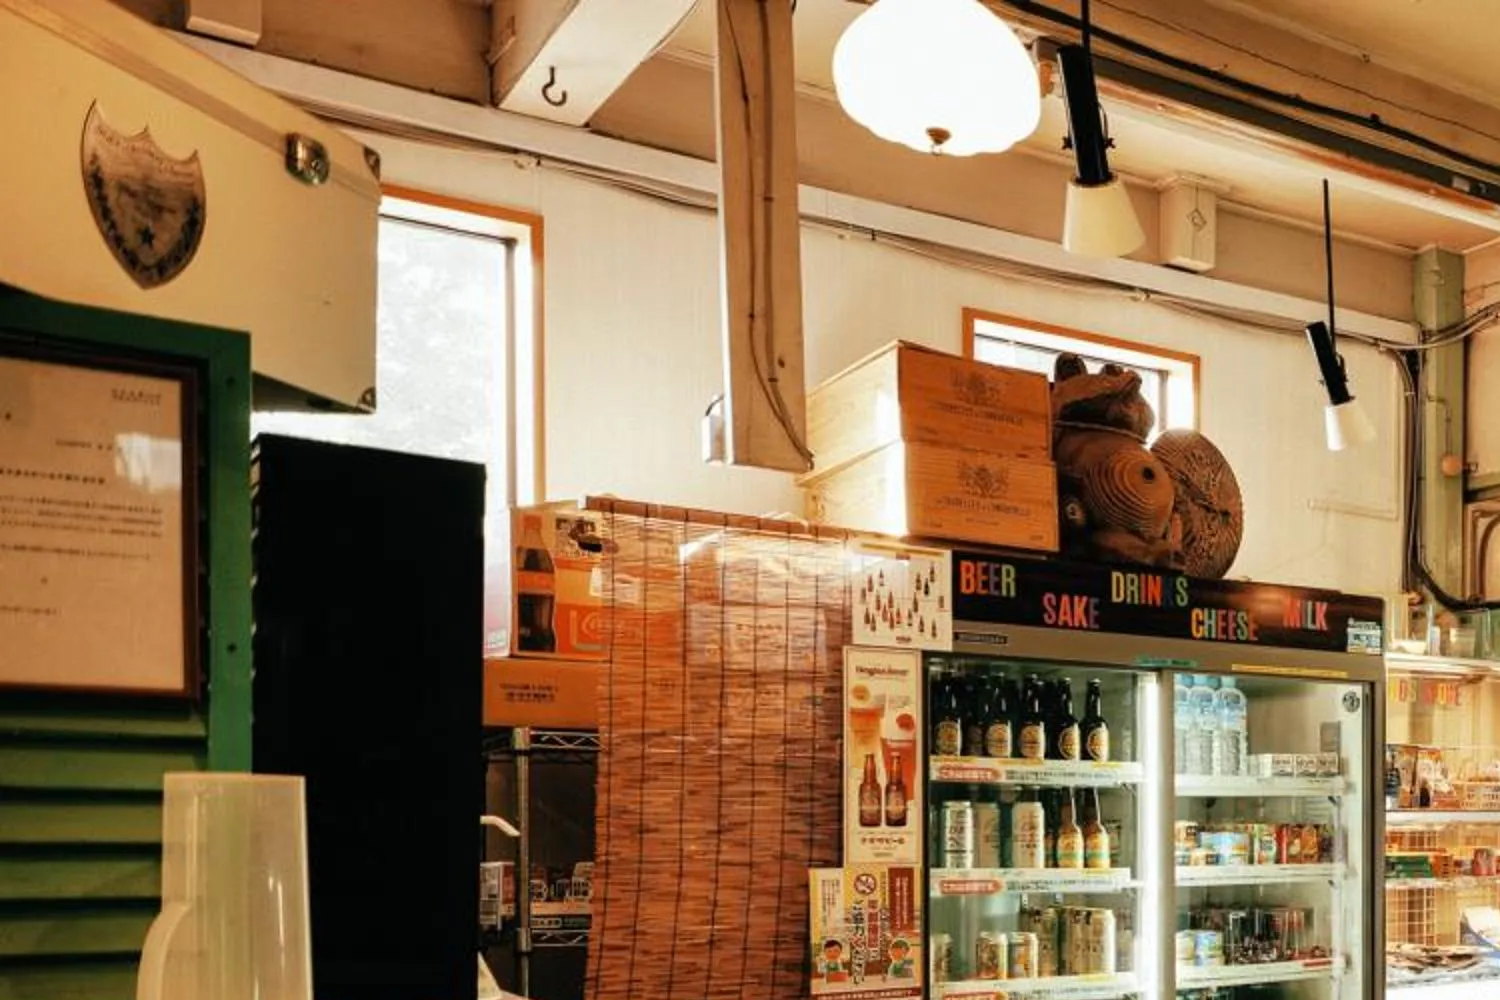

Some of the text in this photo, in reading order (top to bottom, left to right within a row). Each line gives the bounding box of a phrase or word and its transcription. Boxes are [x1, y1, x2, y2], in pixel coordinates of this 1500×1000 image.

[959, 559, 1017, 598] BEER
[1042, 592, 1100, 629] SAKE
[1191, 607, 1259, 641] CHEESE
[1282, 595, 1329, 631] MILK
